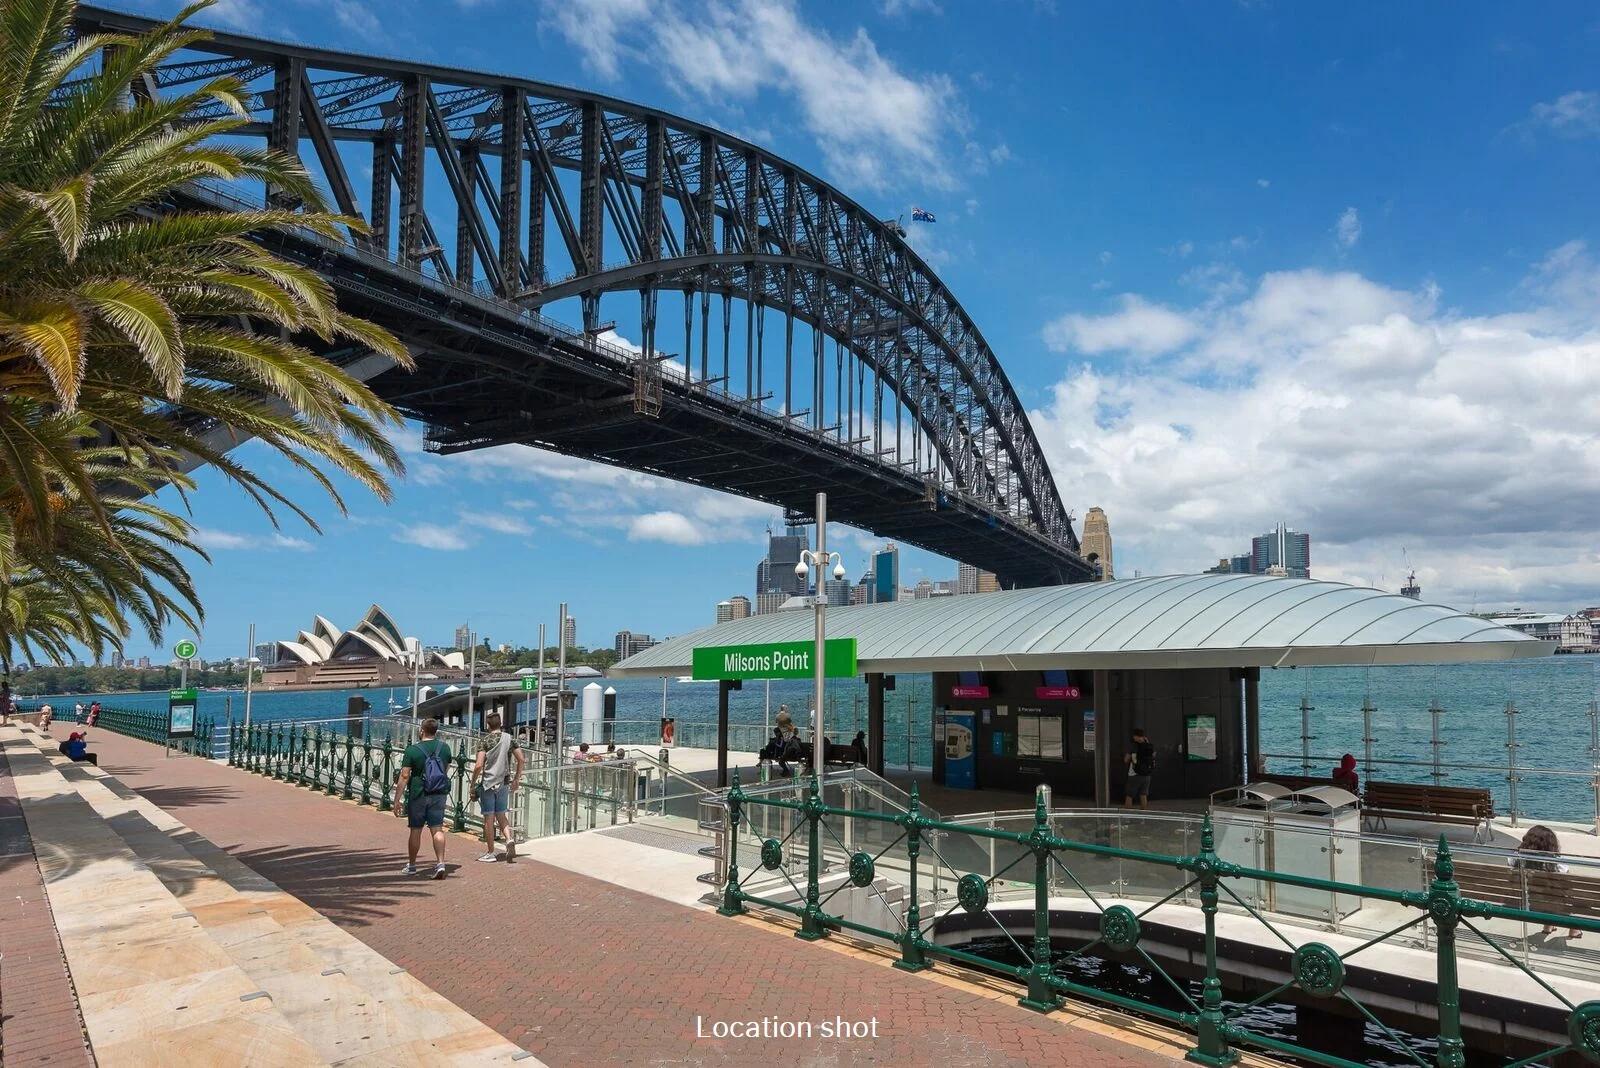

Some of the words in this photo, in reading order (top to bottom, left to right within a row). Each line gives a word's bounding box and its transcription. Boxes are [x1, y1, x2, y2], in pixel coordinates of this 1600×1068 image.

[182, 644, 190, 655] F
[724, 653, 770, 672] Milsons
[773, 650, 809, 671] Point
[526, 681, 532, 690] B
